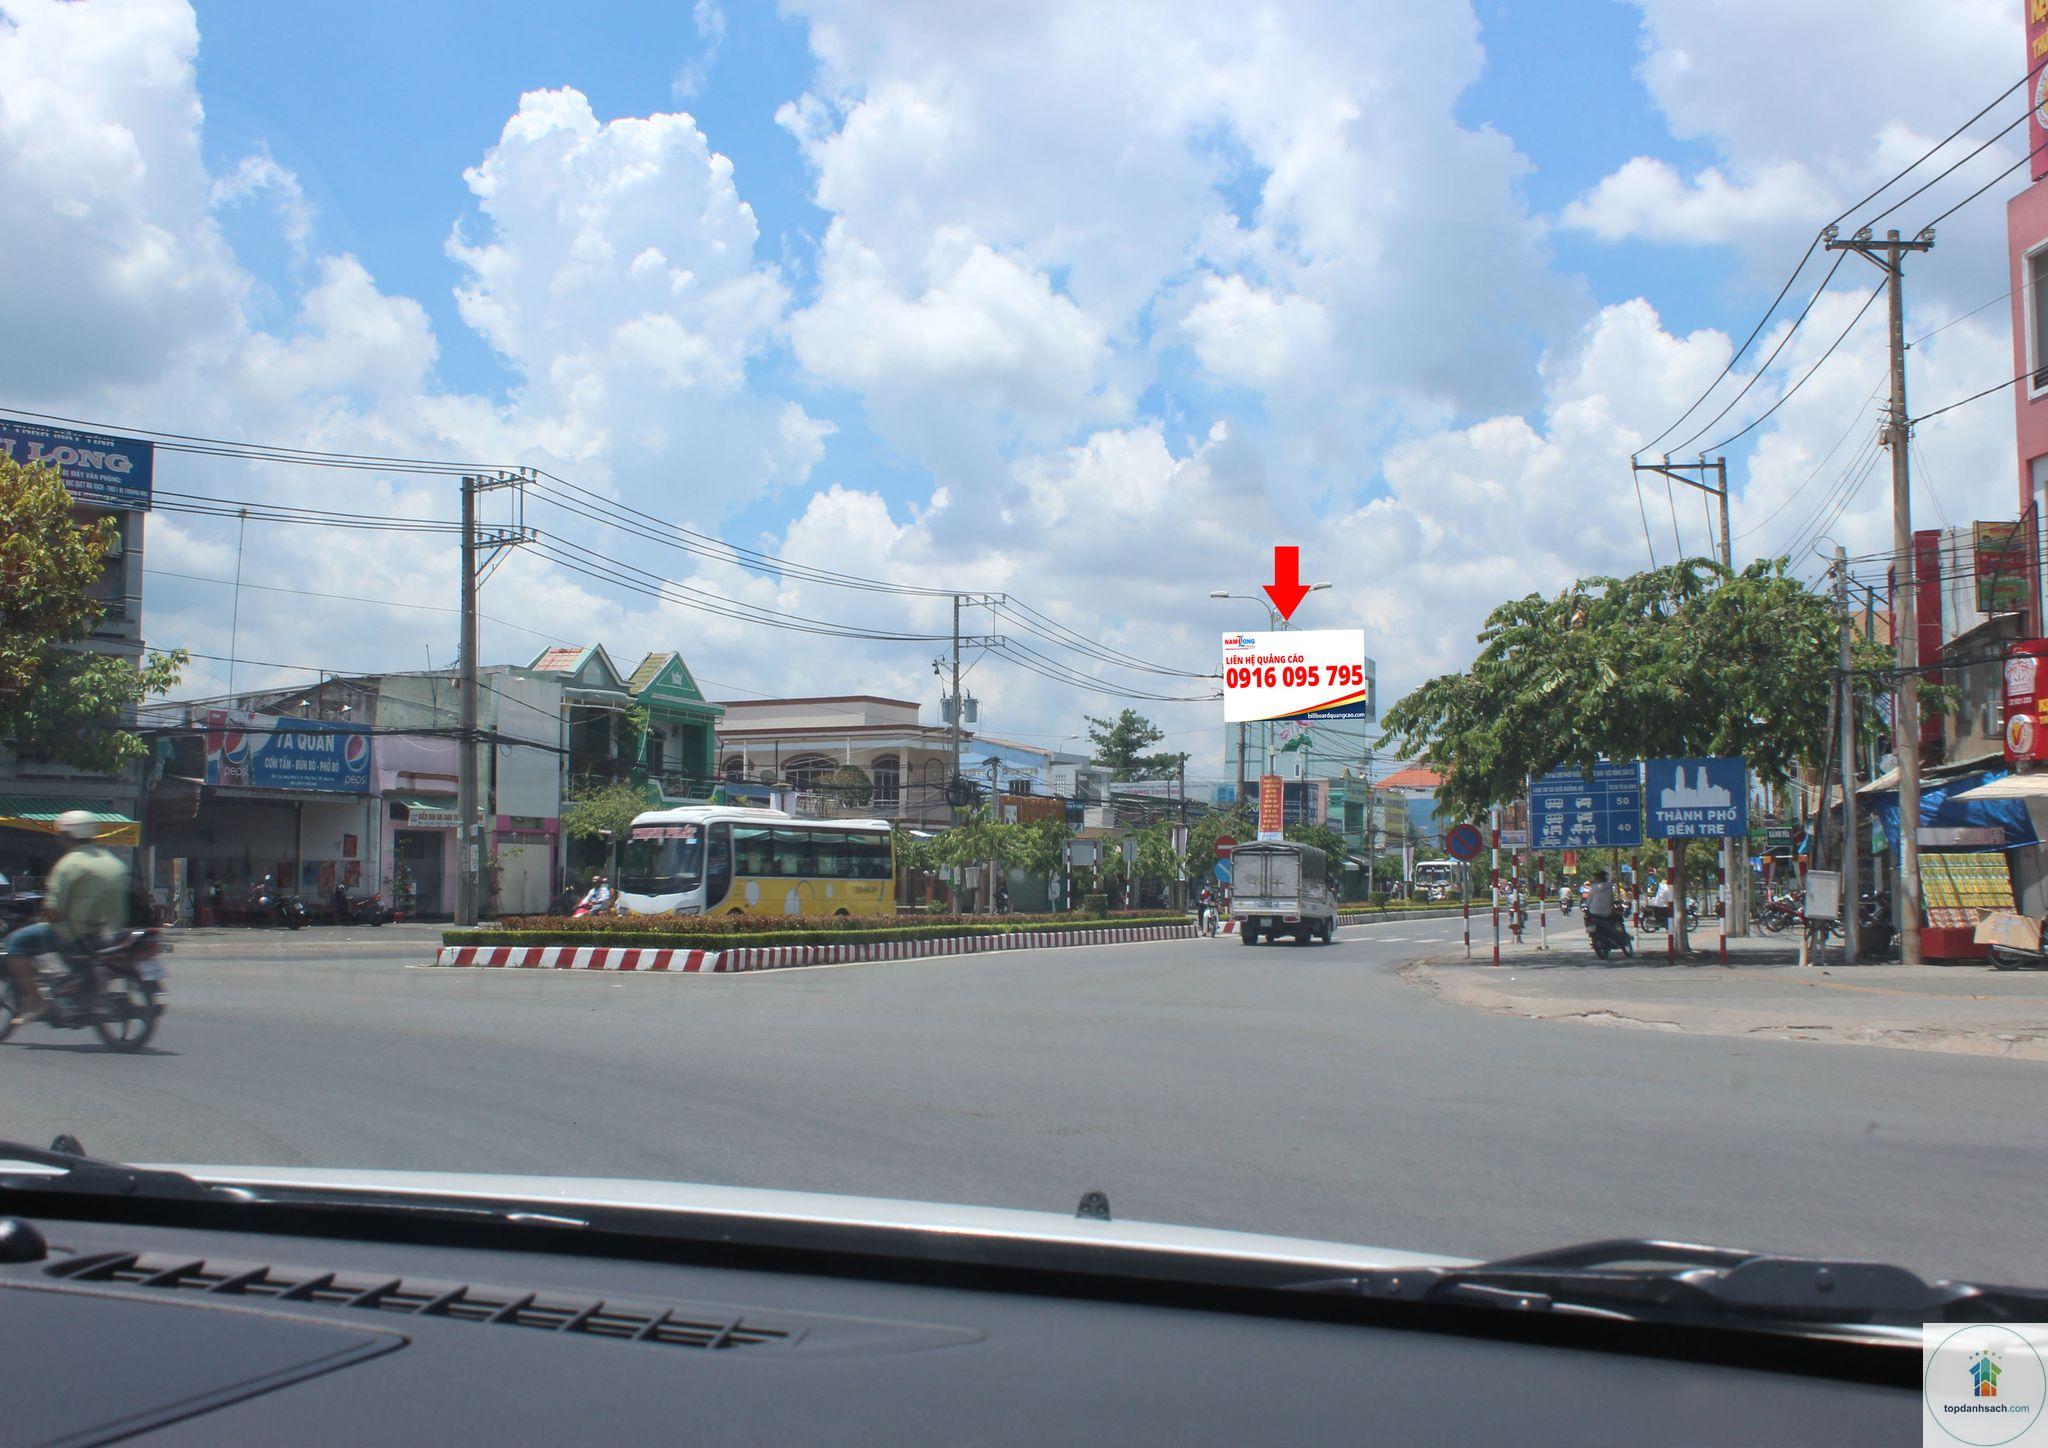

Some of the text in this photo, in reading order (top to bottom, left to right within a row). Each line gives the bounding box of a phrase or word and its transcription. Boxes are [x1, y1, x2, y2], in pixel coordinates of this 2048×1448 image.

[28, 441, 133, 474] LONG
[1226, 654, 1304, 666] LIÊN HỆ QUẢNG CÁO
[1226, 665, 1363, 688] 0916 095 795
[1308, 712, 1365, 720] billboardquangcao.com
[1616, 797, 1629, 805] 50
[1656, 806, 1737, 822] THÀNH PHỐ
[1617, 823, 1631, 832] 40
[1667, 822, 1725, 835] BẾN TRE
